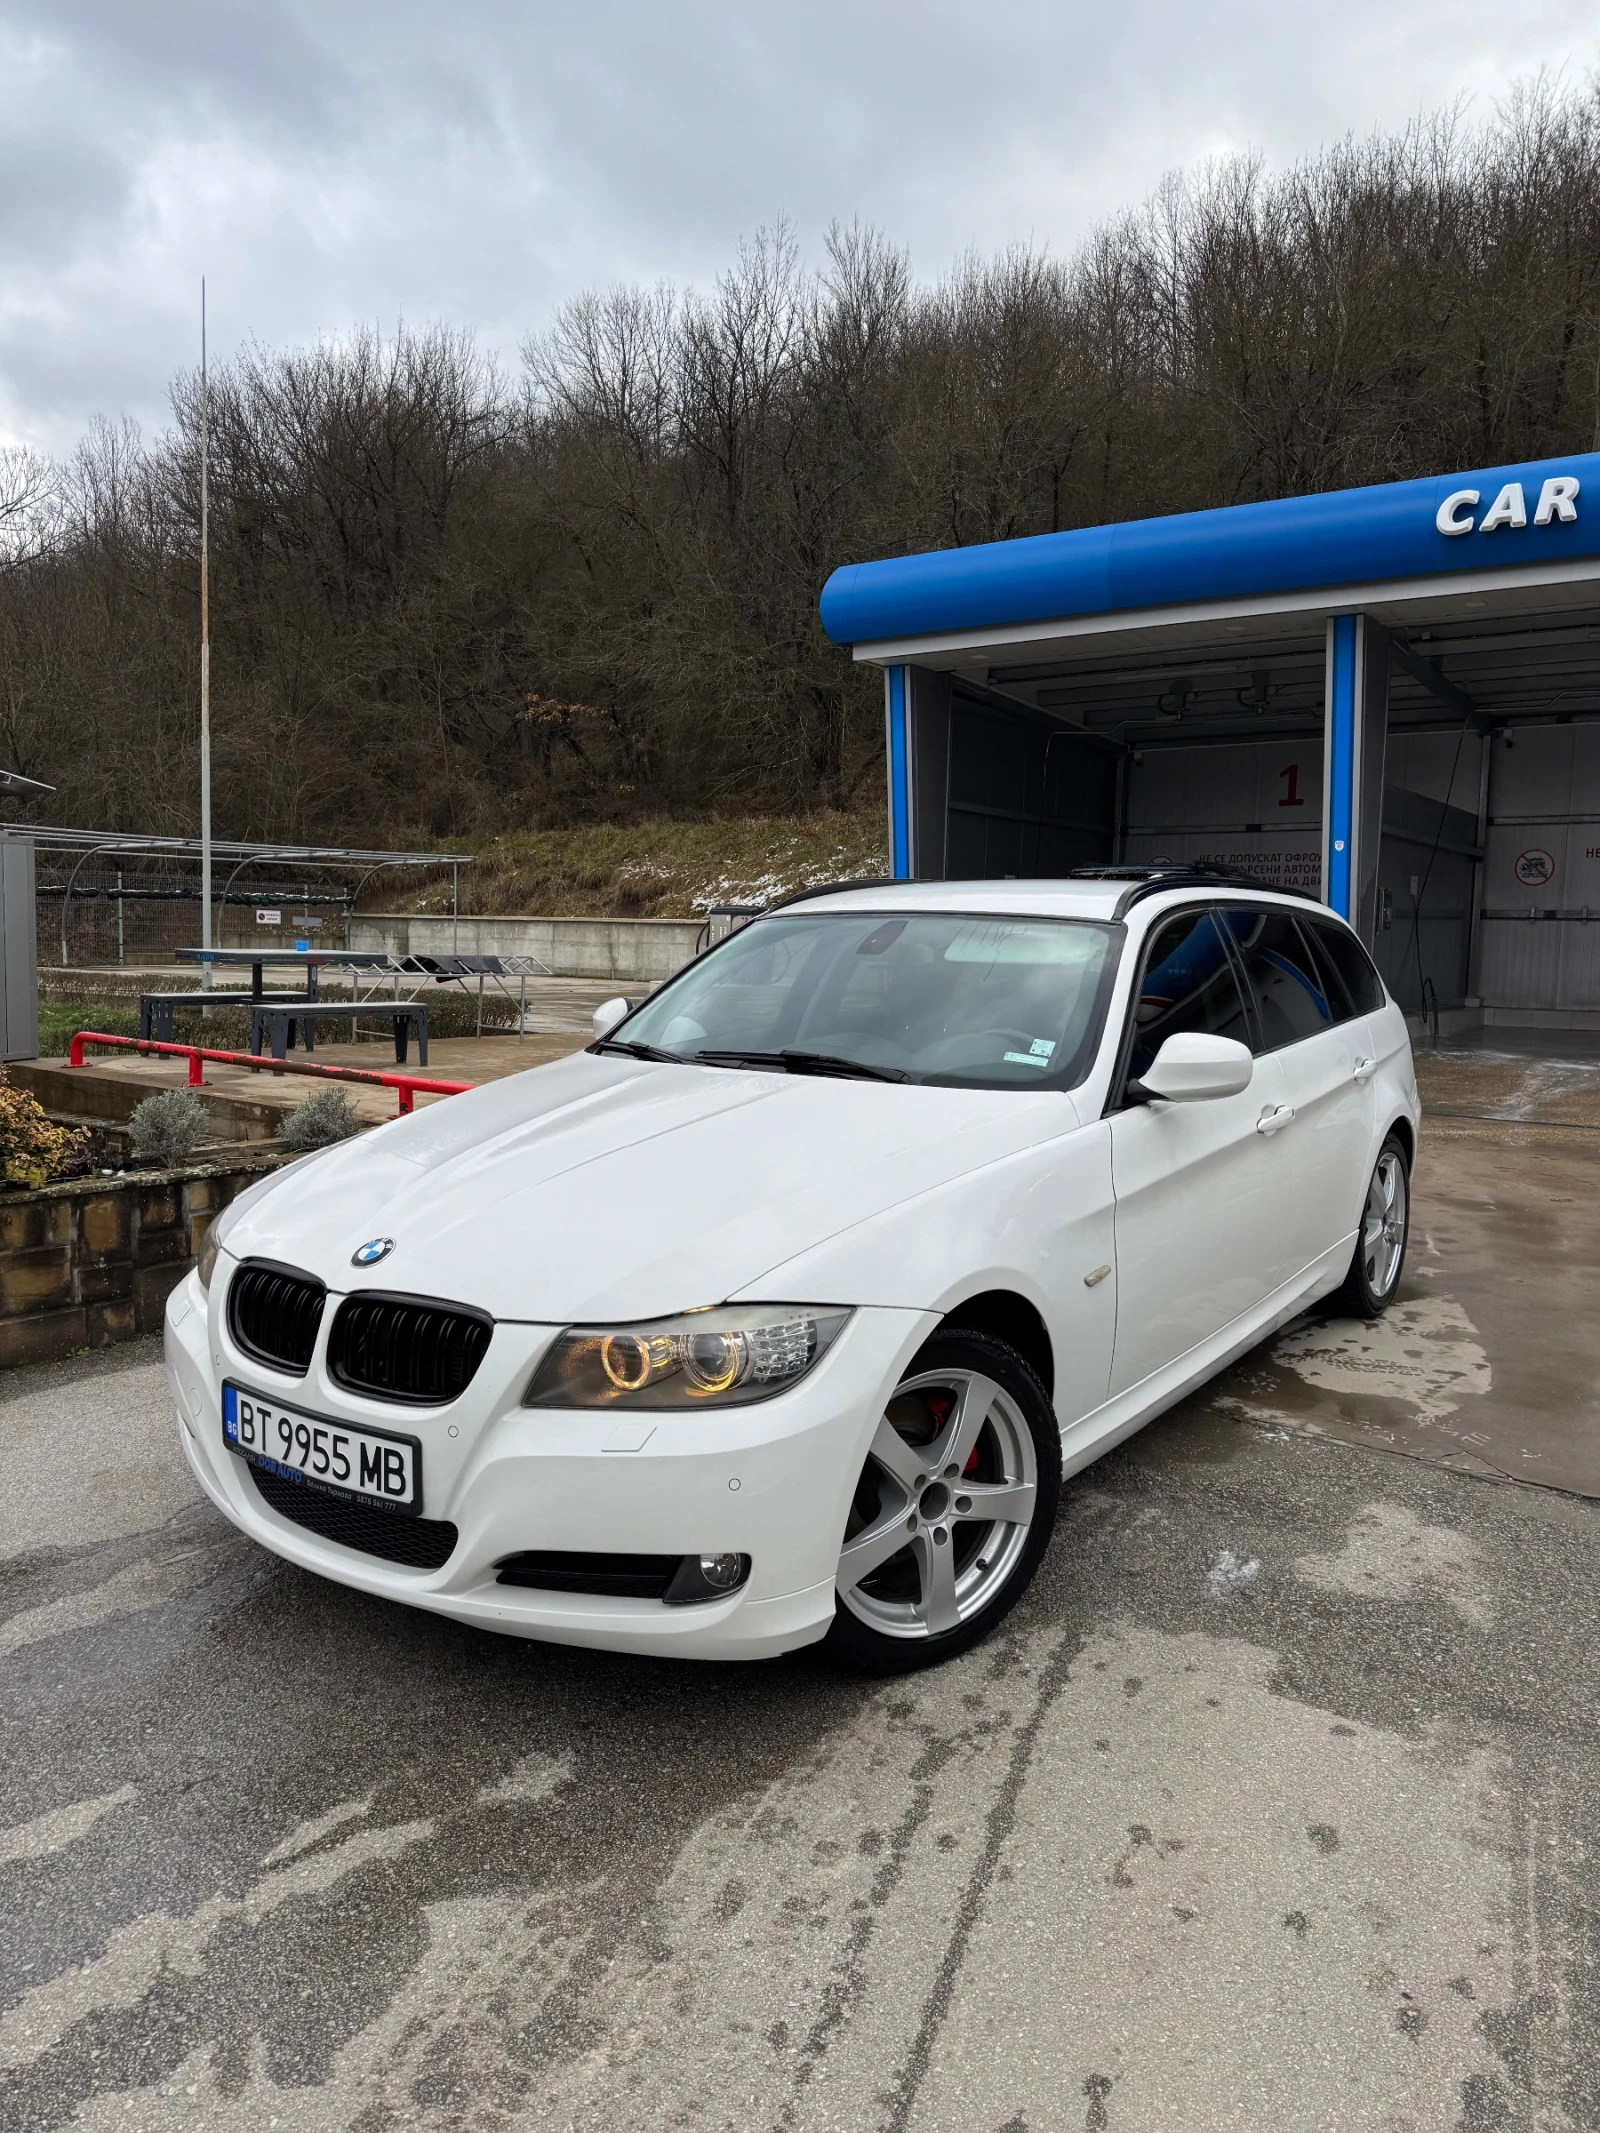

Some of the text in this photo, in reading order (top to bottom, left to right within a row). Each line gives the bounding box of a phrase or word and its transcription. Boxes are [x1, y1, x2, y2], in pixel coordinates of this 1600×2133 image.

[1436, 476, 1581, 536] CAR
[1278, 764, 1304, 807] 1
[1214, 854, 1226, 863] СЕ
[1228, 853, 1283, 864] ДОПУСКАТ
[1284, 864, 1322, 874] АВТОМ
[1284, 876, 1299, 886] НА
[227, 1420, 238, 1436] BG
[240, 1399, 406, 1497] BT 9955 MB
[277, 1463, 303, 1484] AUTO
[384, 1502, 397, 1511] 777
